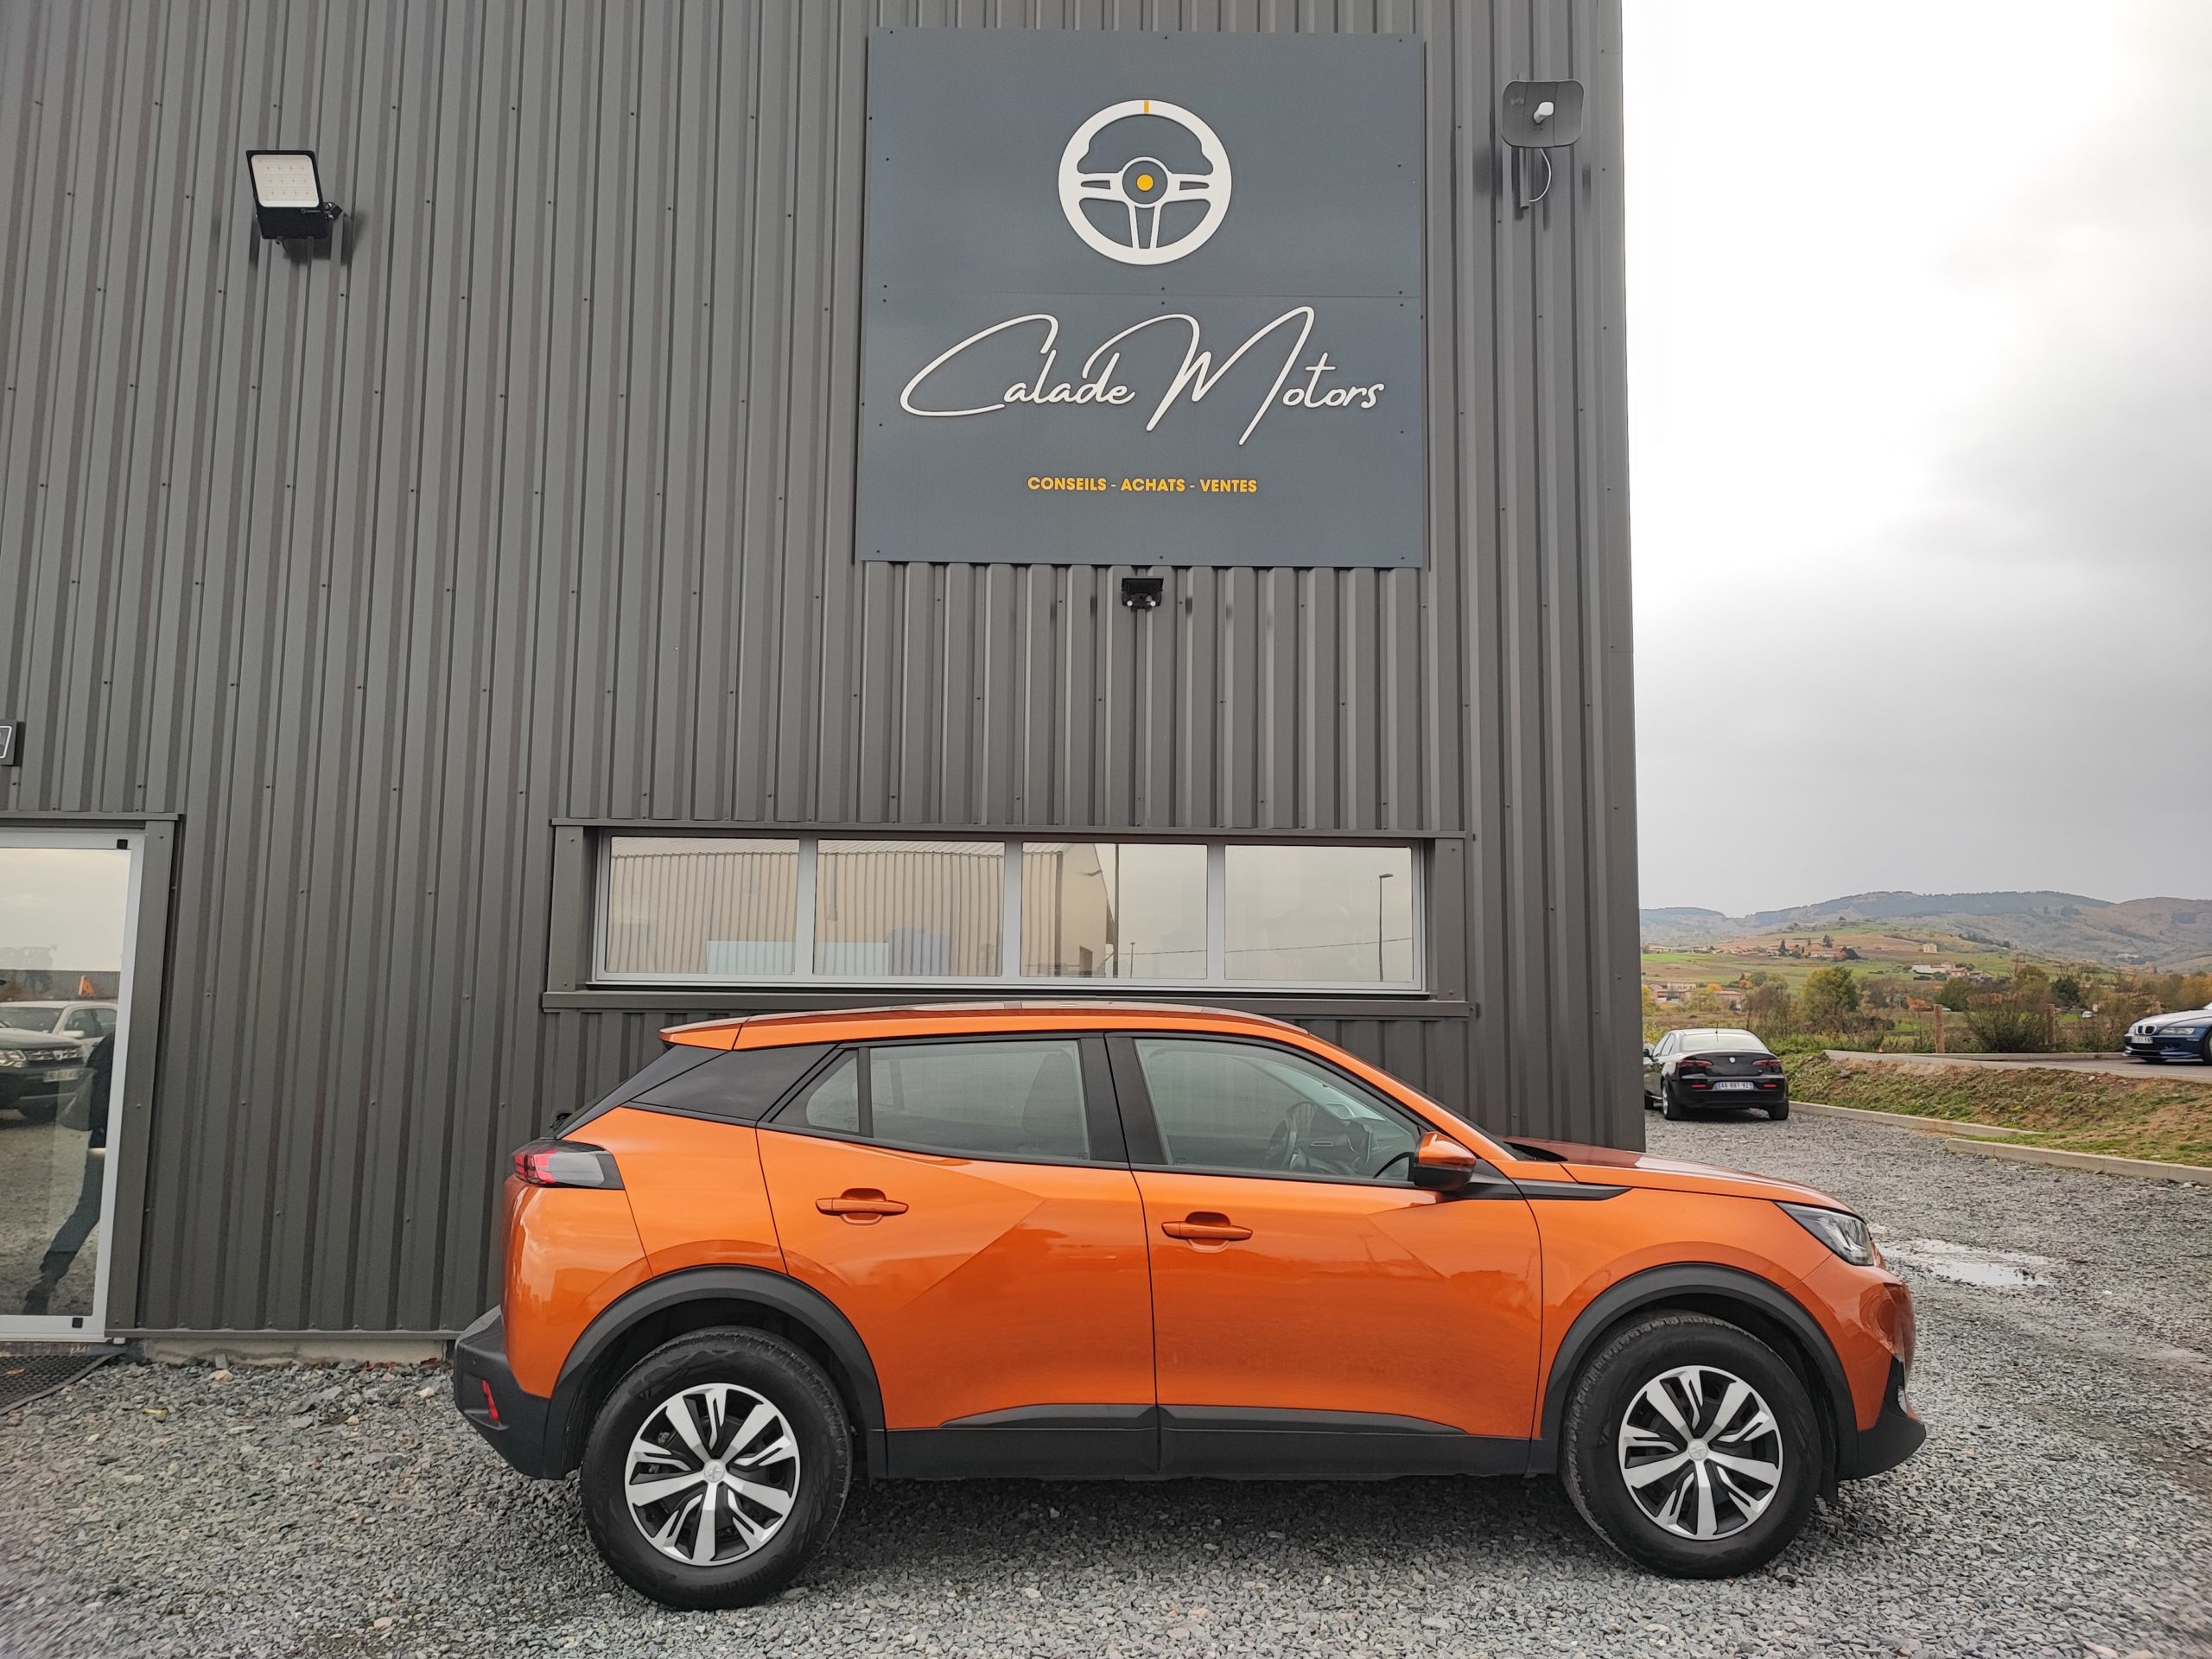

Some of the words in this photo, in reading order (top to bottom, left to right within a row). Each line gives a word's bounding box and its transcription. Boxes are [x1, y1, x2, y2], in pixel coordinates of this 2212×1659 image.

[899, 314, 1135, 416] Calade
[1082, 306, 1385, 446] Motors
[1027, 476, 1107, 492] CONSEILS
[1120, 478, 1185, 493] ACHATS
[1199, 479, 1258, 493] VENTES
